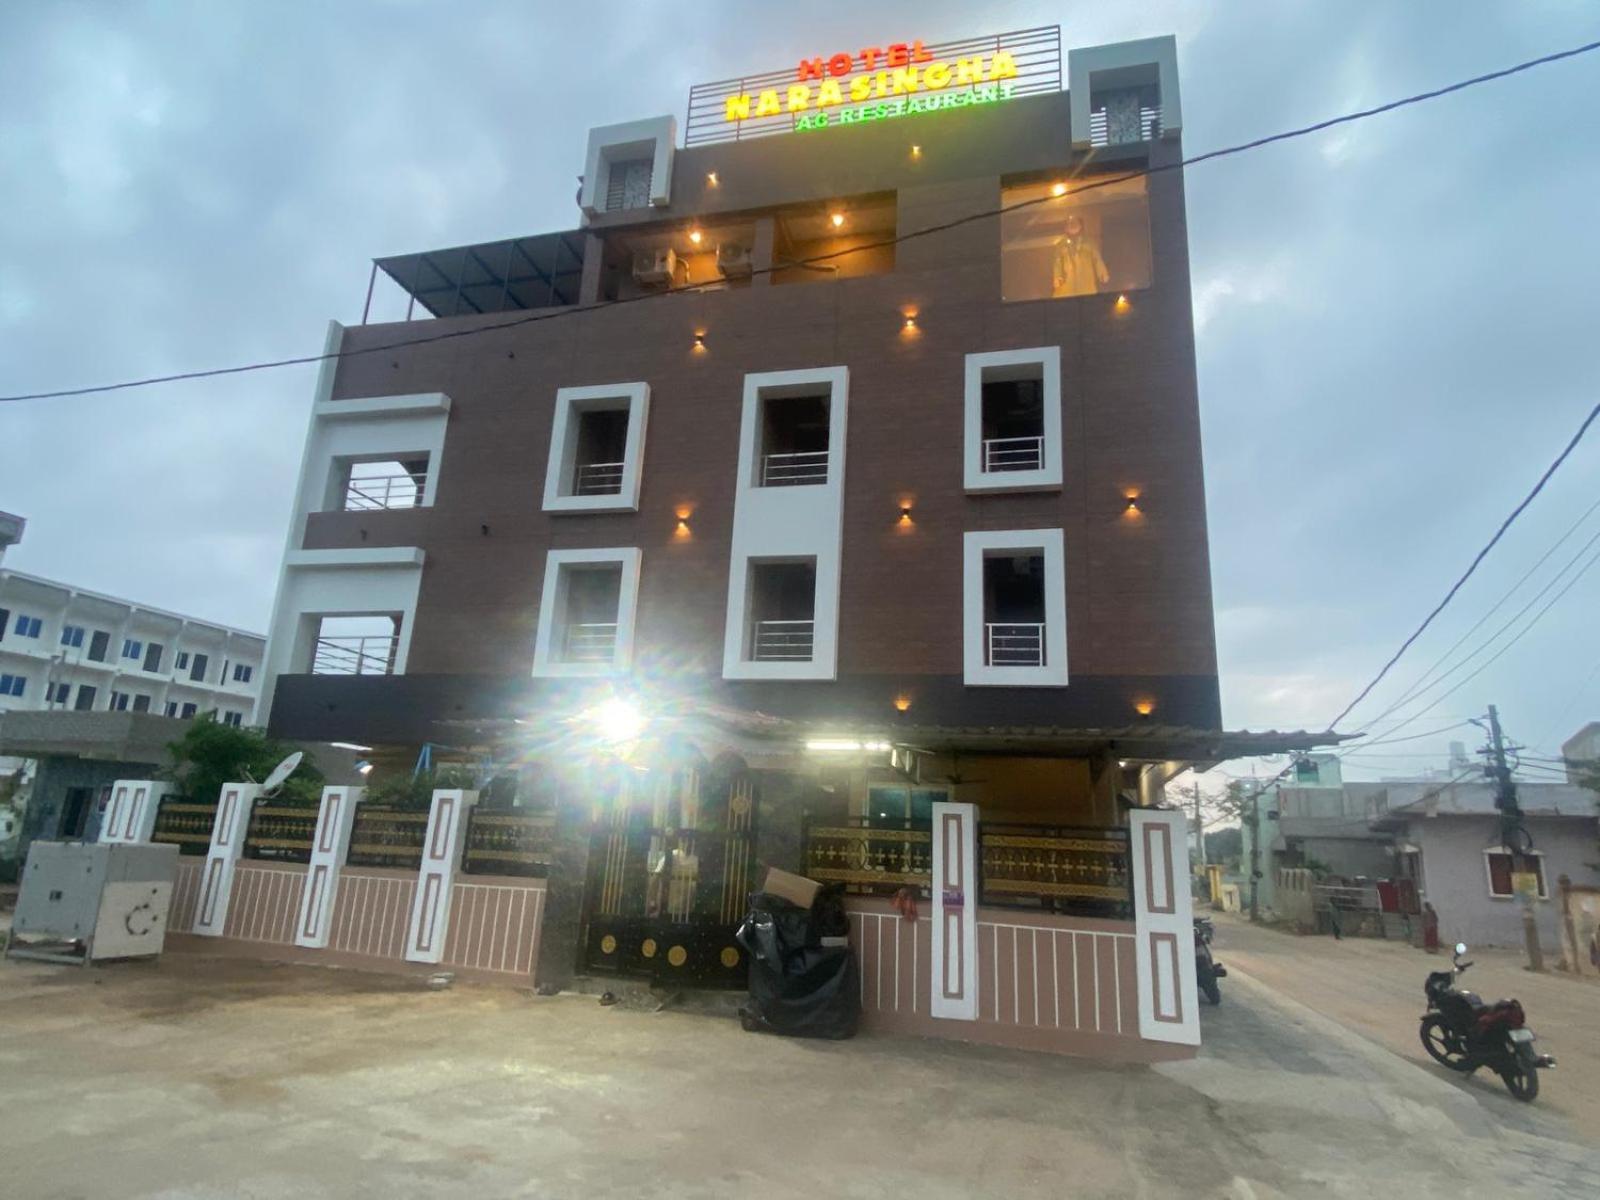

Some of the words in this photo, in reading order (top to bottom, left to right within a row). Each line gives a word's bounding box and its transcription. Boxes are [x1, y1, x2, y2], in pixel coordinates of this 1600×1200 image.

[798, 40, 933, 81] HOTEL
[725, 52, 1018, 121] NARASINGHA
[796, 112, 829, 131] AC
[841, 85, 1016, 124] RESTAURANT
